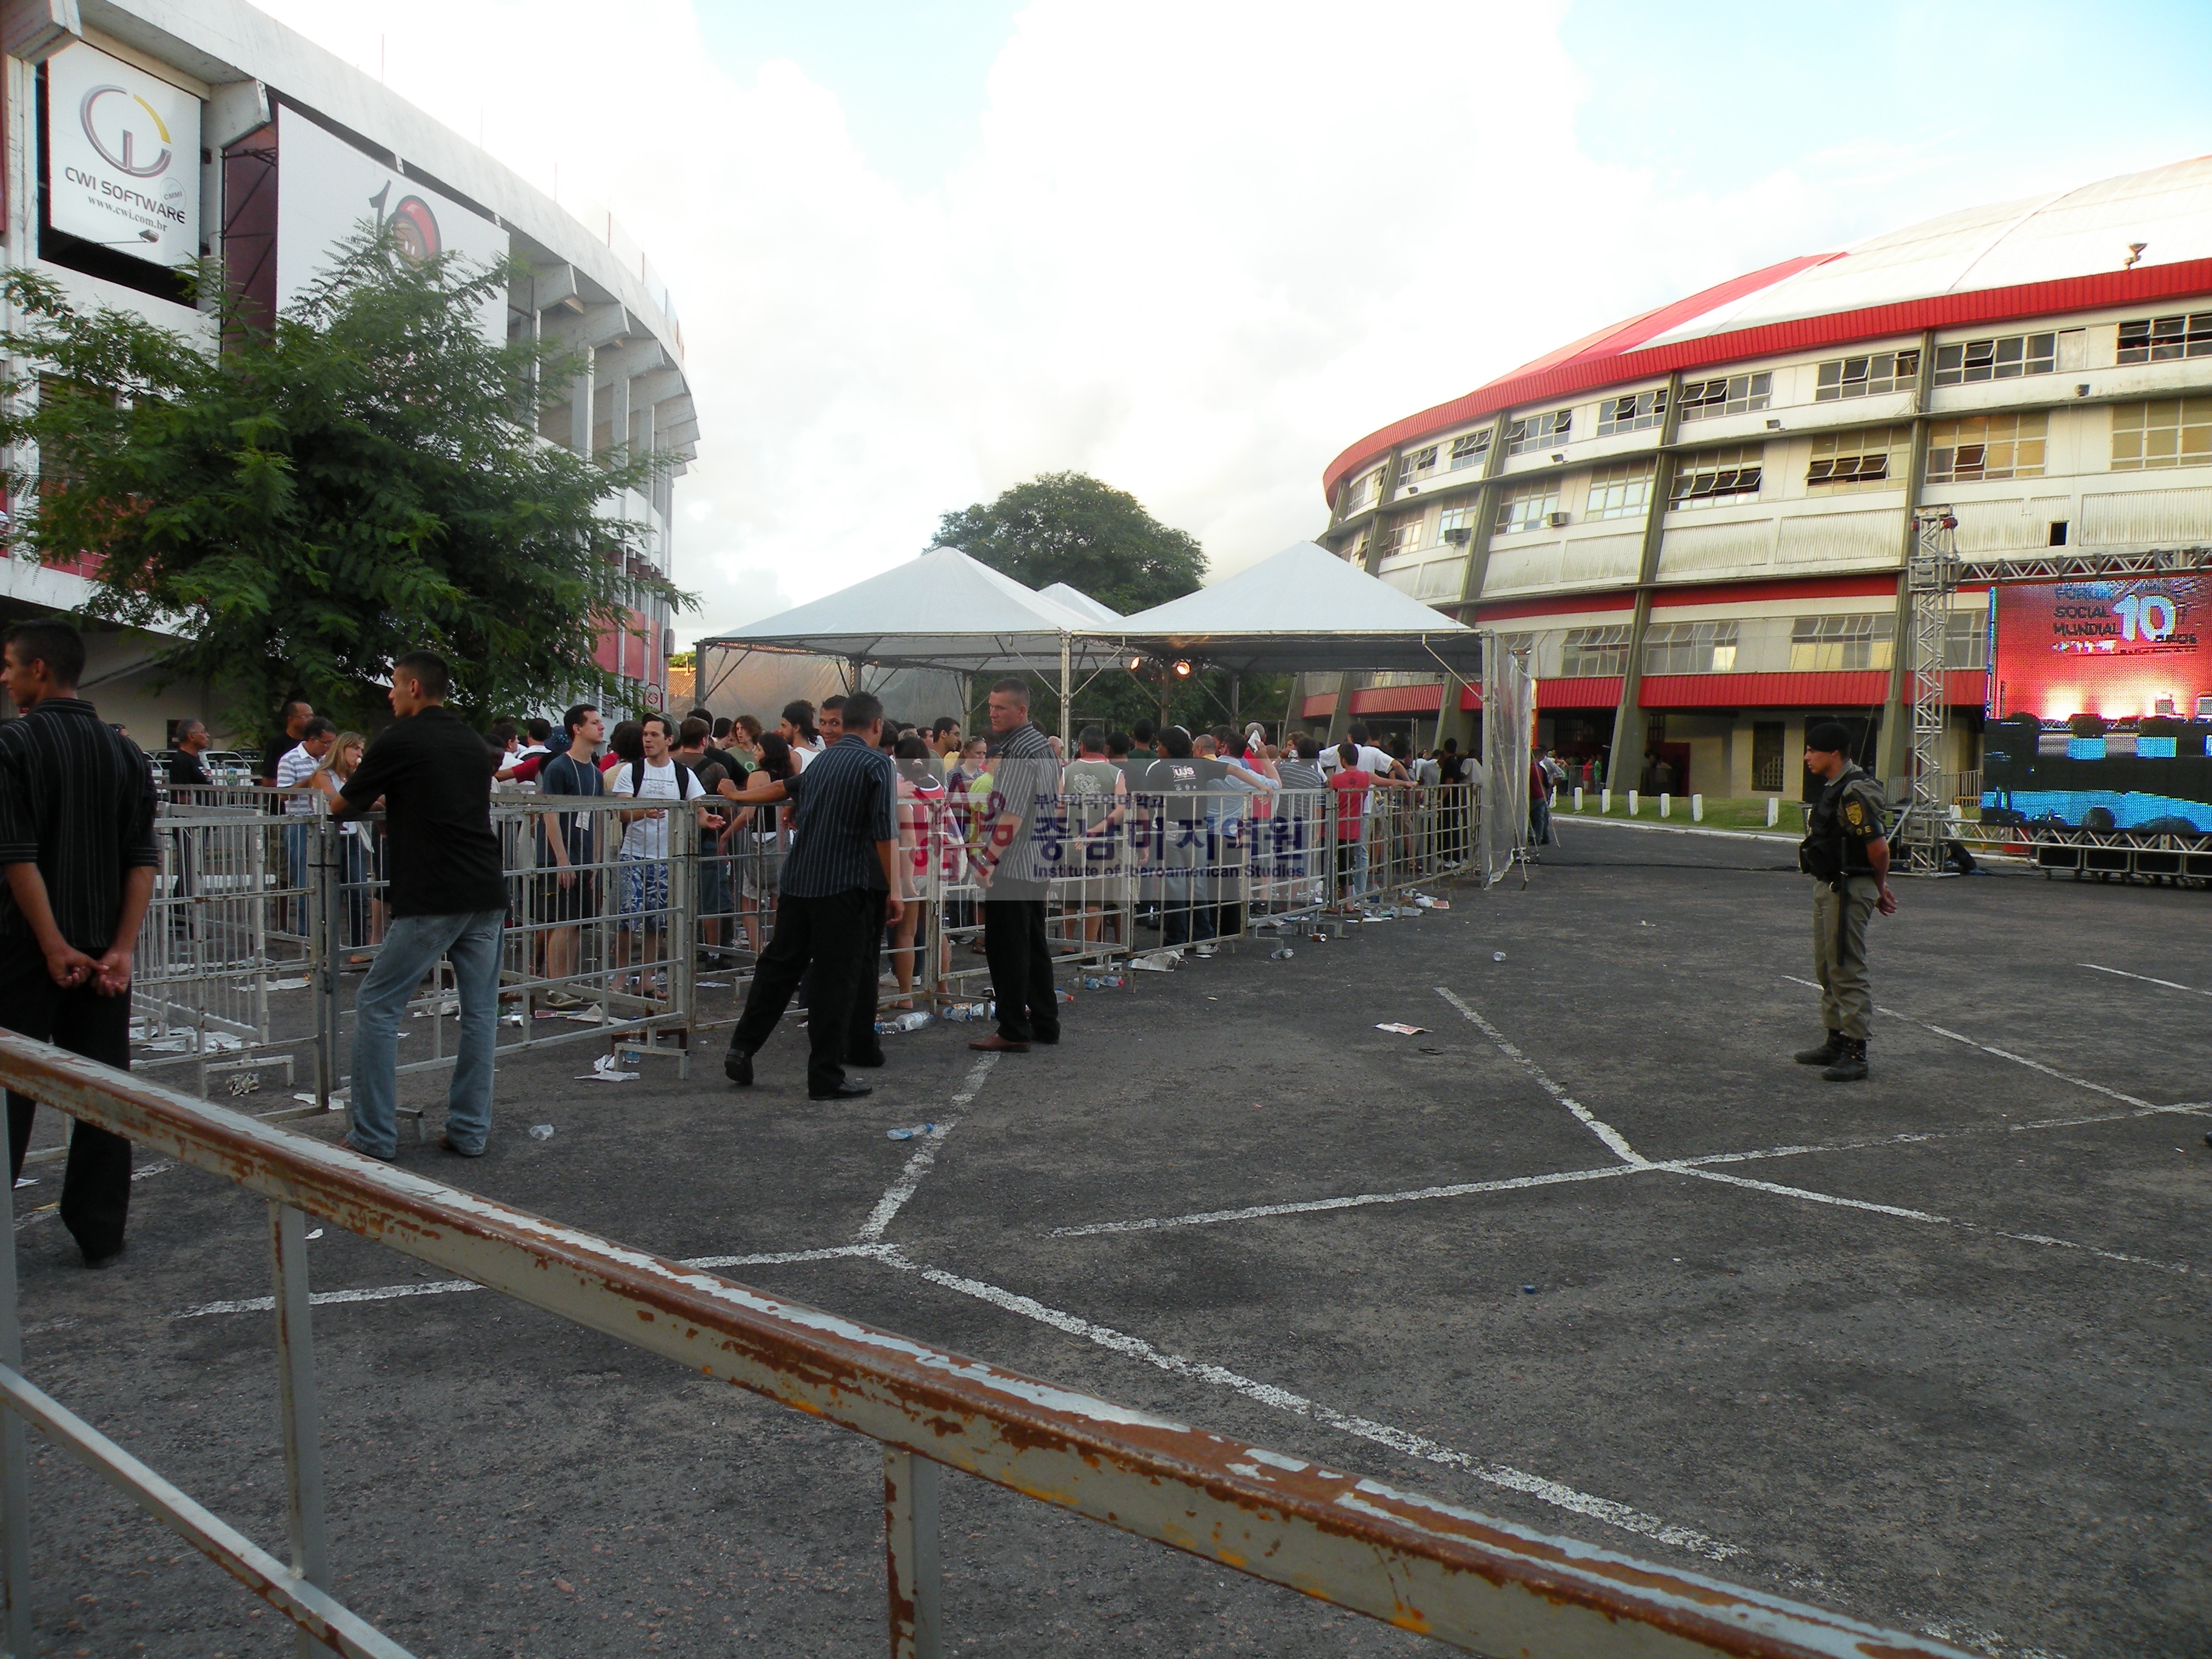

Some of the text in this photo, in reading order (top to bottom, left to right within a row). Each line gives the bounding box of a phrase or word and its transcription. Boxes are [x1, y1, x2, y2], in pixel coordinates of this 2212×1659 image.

[65, 166, 185, 224] CWI SOFTWARE
[164, 190, 183, 201] CMMI
[88, 196, 168, 232] www.cwi.com.br
[2054, 606, 2111, 618] SOCIAL
[2112, 594, 2176, 642] 10
[2053, 623, 2123, 636] MUNDIAL
[1174, 766, 1195, 777] UJS
